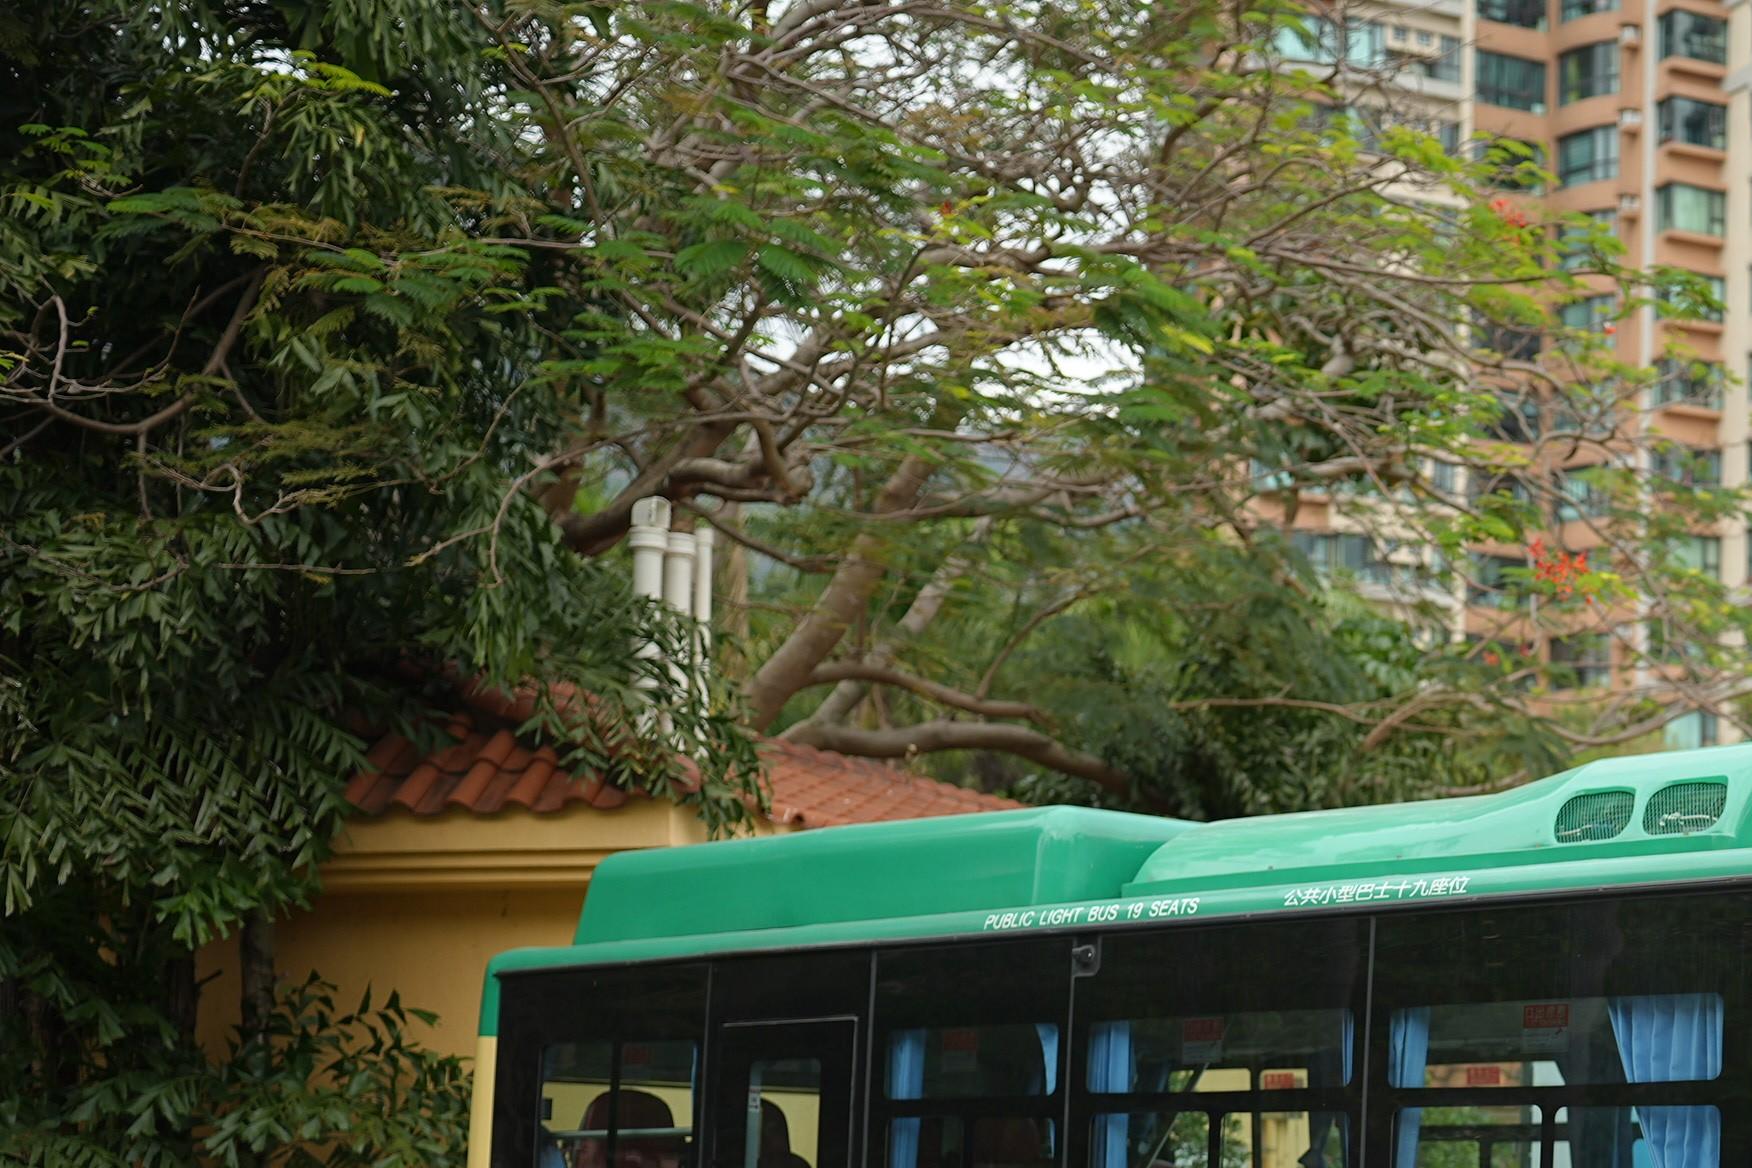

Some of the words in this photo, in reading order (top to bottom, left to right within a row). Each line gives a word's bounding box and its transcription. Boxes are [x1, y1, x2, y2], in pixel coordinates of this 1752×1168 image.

[1283, 876, 1471, 907] 公共小型巴士十九座位
[984, 910, 1035, 931] PUBLIC
[1038, 906, 1084, 927] LIGHT
[1087, 904, 1120, 923] BUS
[1127, 902, 1144, 919] 19
[1149, 897, 1201, 917] SEATS
